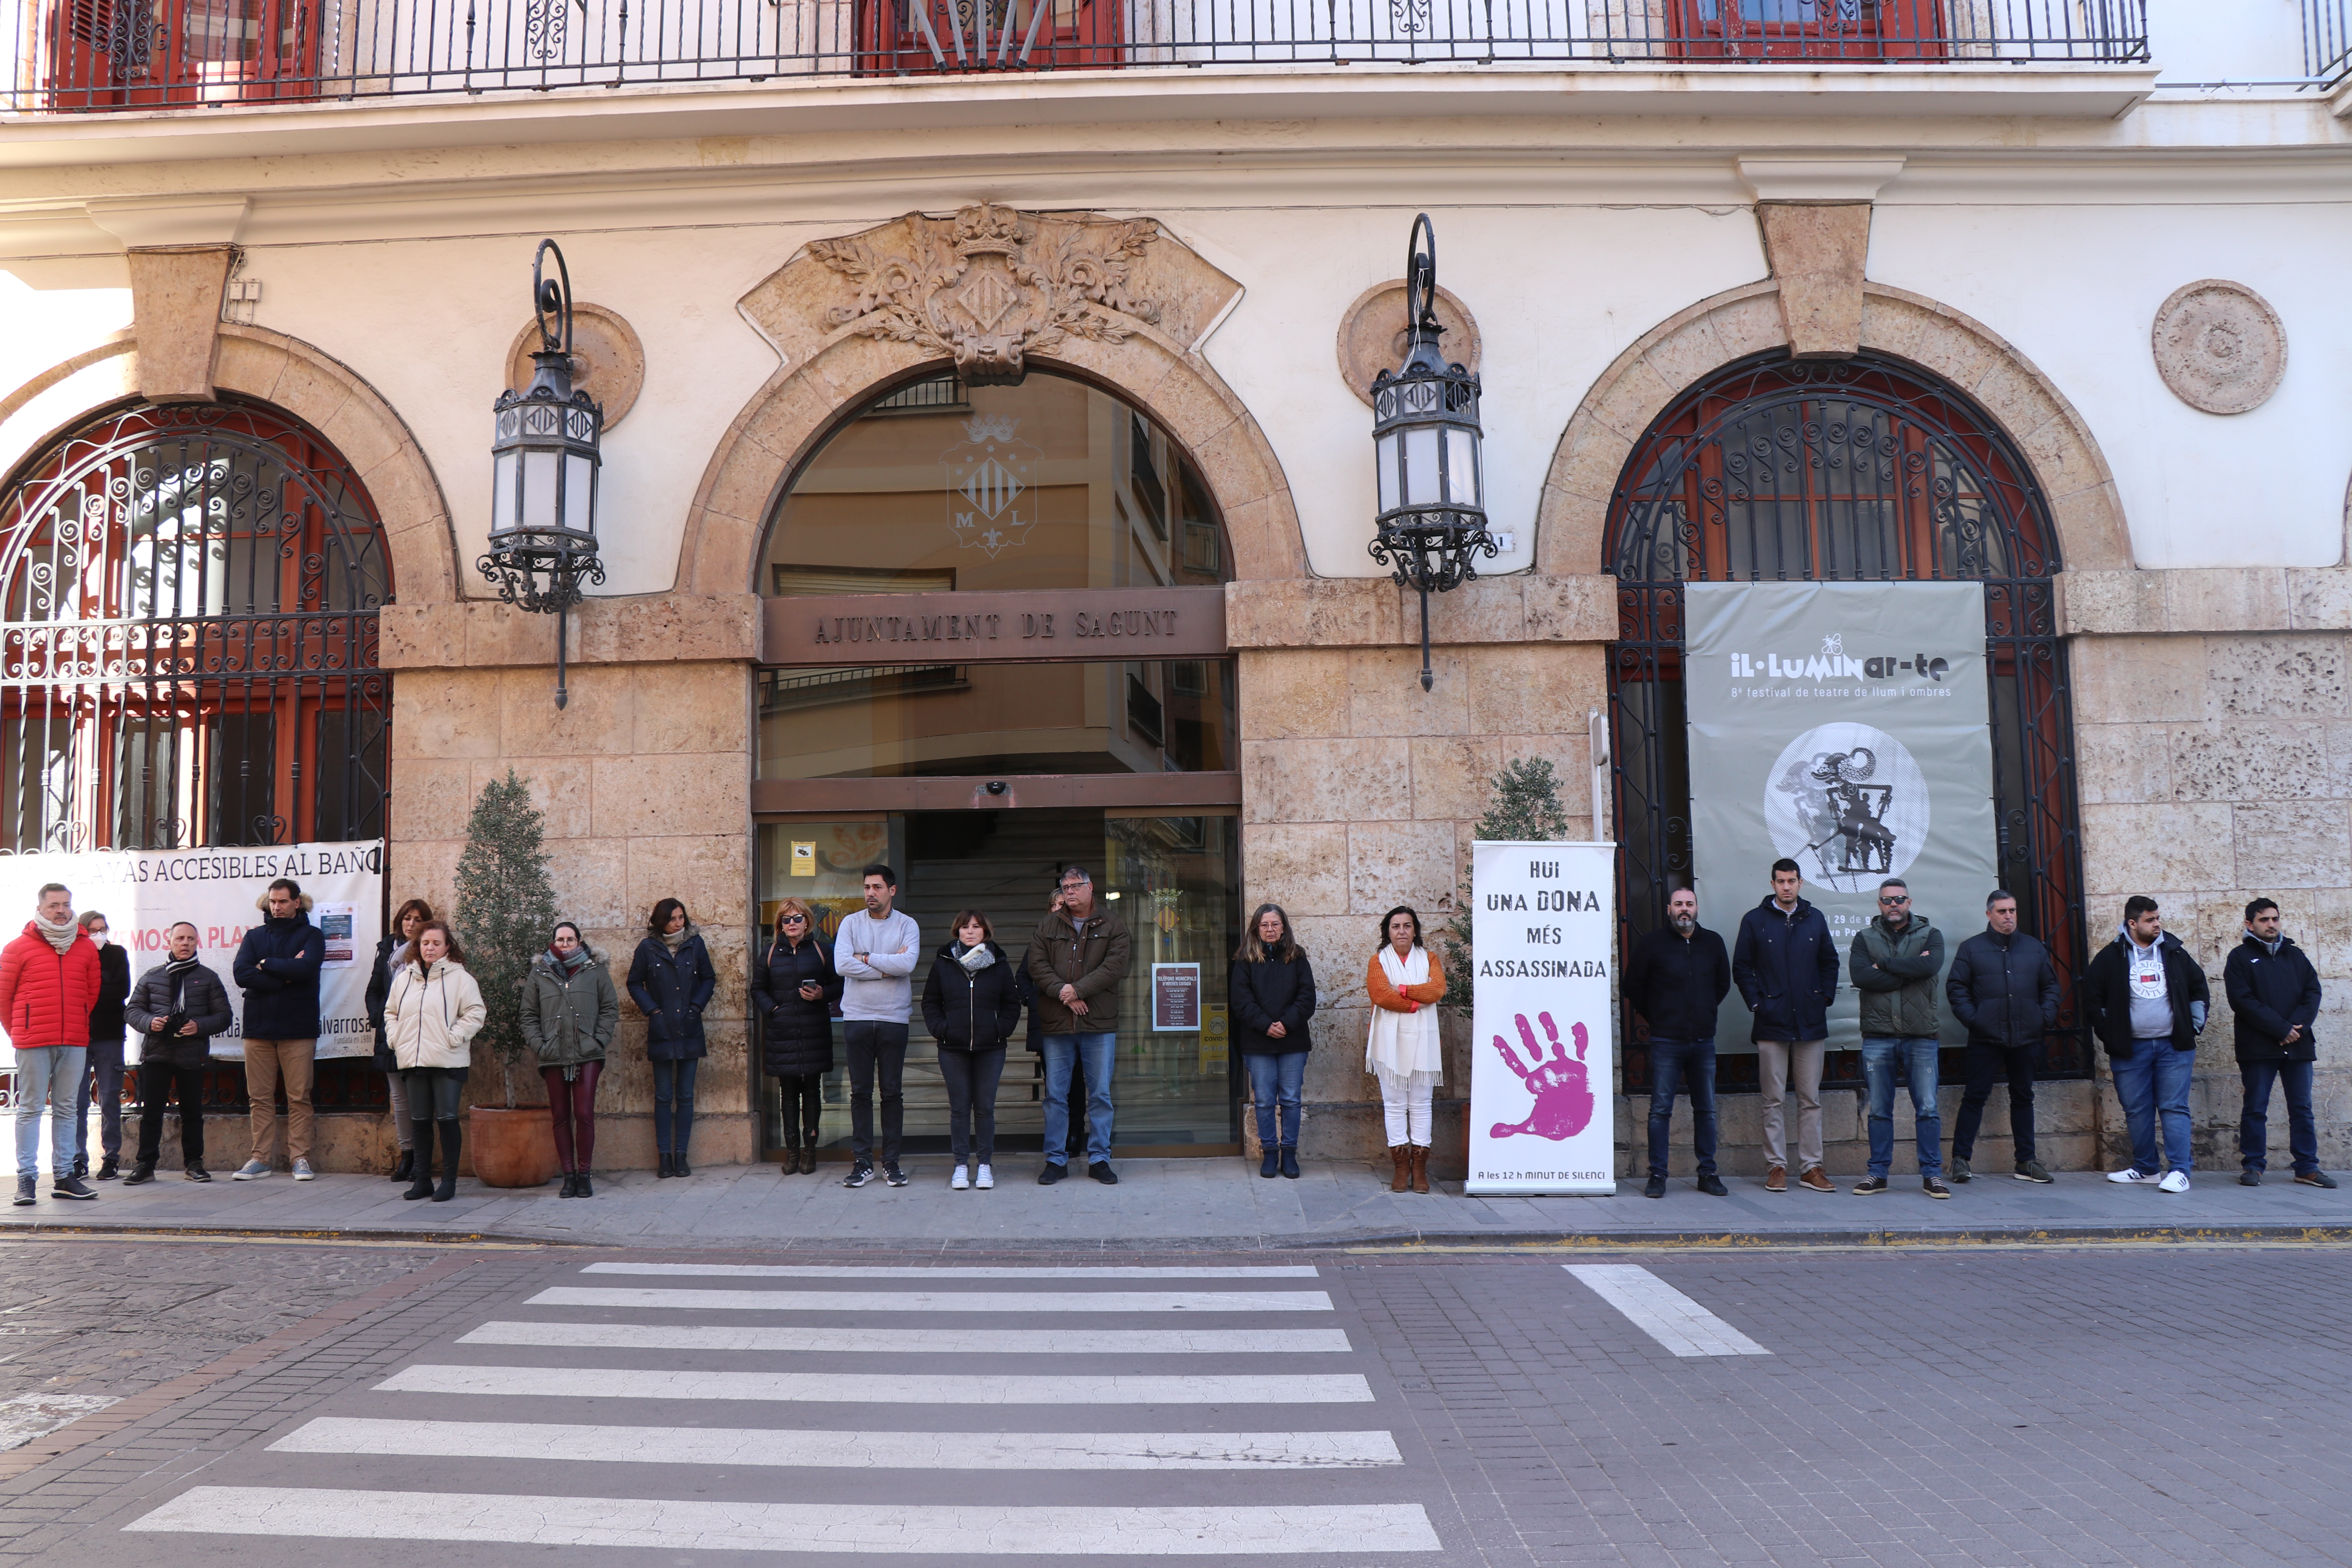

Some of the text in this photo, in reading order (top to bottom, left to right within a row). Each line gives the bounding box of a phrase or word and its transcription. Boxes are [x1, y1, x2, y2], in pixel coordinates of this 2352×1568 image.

[955, 510, 1027, 528] M L
[1498, 536, 1504, 547] 1
[815, 610, 1177, 643] AJUNTAMENT DE SAGUNT
[1747, 687, 1790, 697] festival
[1796, 687, 1809, 697] de
[1814, 688, 1849, 697] teatre
[1855, 687, 1867, 697] de
[1873, 686, 1896, 697] llum
[1902, 687, 1904, 697] i
[1910, 687, 1951, 697] ombres
[154, 855, 277, 882] ACCESIBLES
[283, 853, 312, 877] AL
[1530, 860, 1559, 878] HUI
[1487, 890, 1601, 912] UNA DONA
[1834, 915, 1846, 924] 29
[1850, 915, 1861, 924] de
[1527, 924, 1562, 945] MÉS
[1480, 960, 1607, 978] ASSASSINADA
[334, 1036, 352, 1044] Fundada
[360, 1034, 372, 1043] 1986
